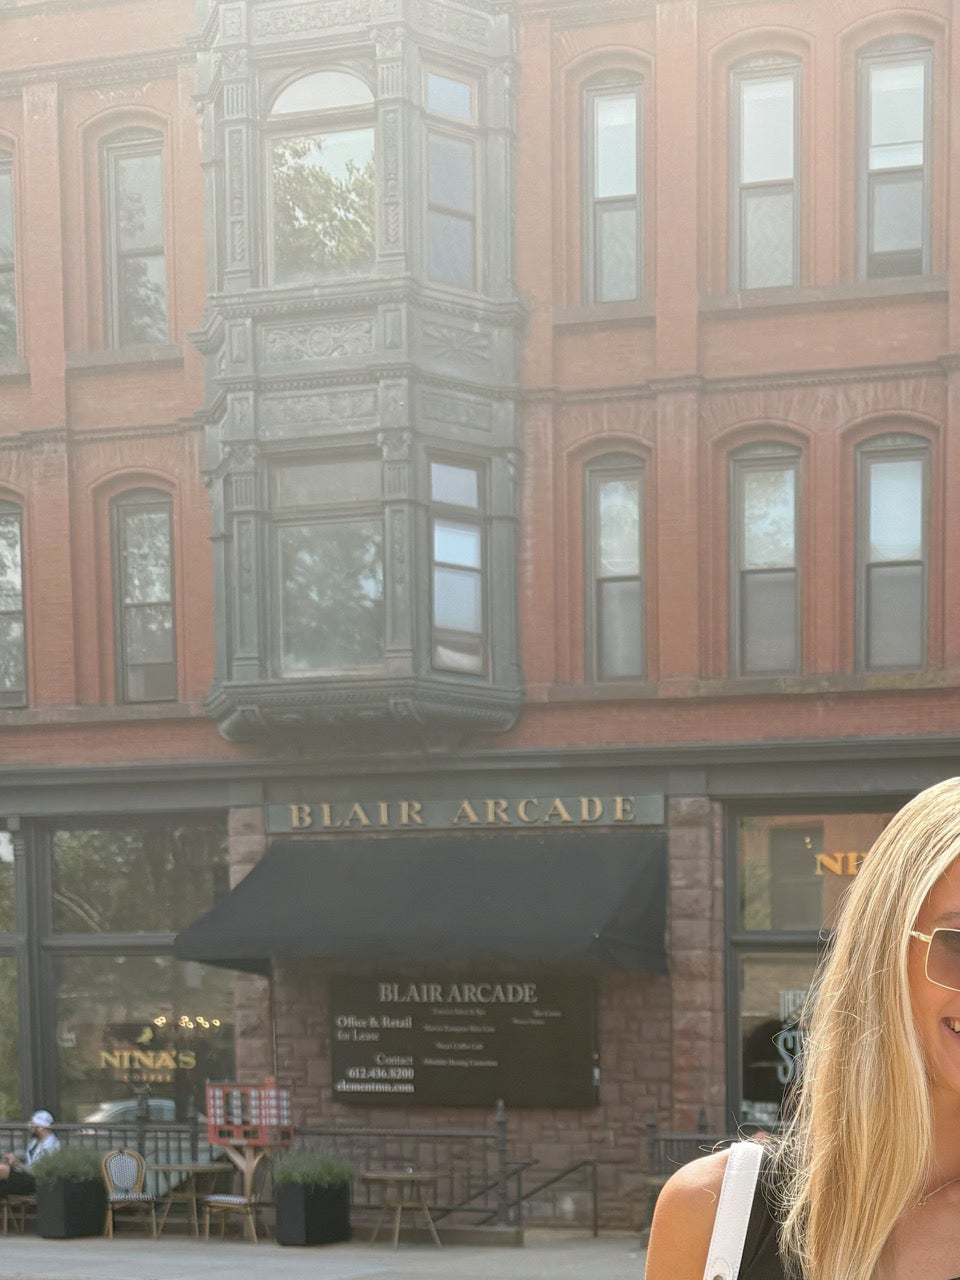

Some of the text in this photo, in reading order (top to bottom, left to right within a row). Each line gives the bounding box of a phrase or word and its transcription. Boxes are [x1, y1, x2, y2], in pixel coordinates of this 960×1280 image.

[289, 795, 638, 829] BLAIR ARCADE
[379, 983, 538, 1003] BLAIR ARCADE
[337, 1016, 367, 1028] Office
[369, 1017, 380, 1028] &
[383, 1016, 413, 1028] Retail
[337, 1029, 380, 1041] for Lease
[98, 1049, 197, 1070] NINA'S
[375, 1053, 414, 1065] Contact
